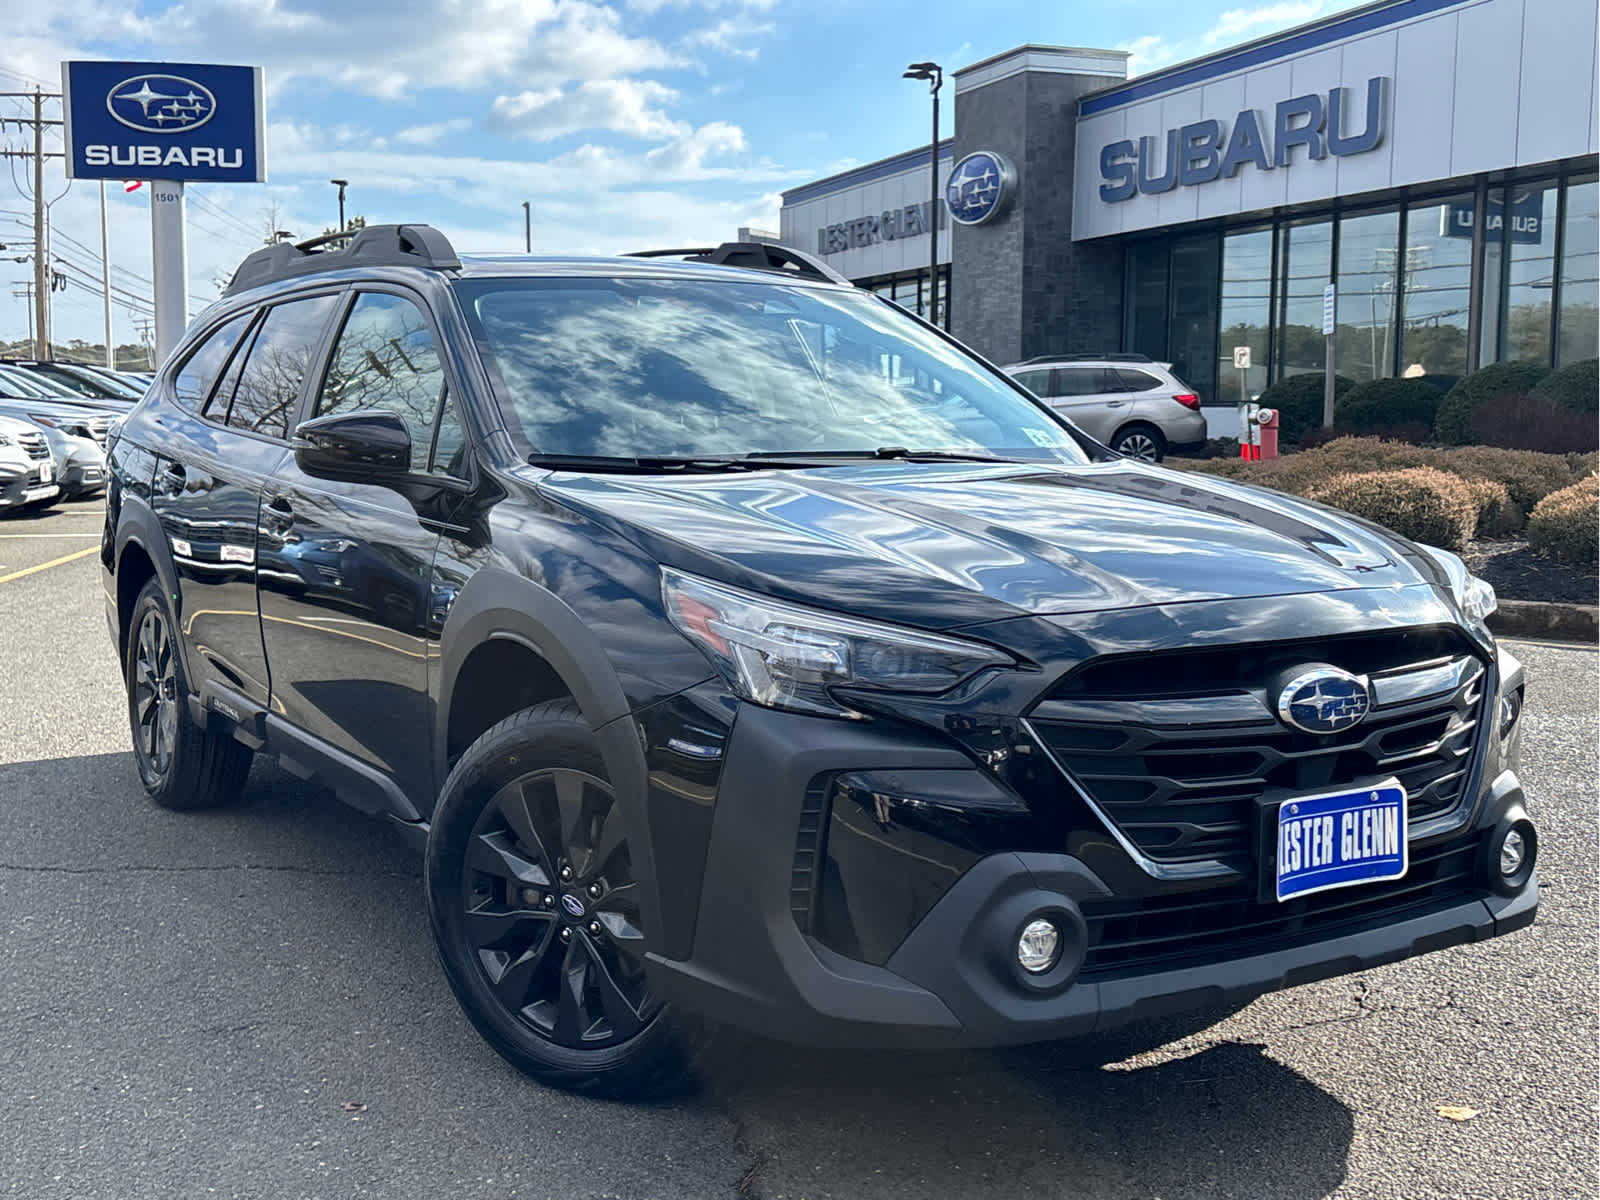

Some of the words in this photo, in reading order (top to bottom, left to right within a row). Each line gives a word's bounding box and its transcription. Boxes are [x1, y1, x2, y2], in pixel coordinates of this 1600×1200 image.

[85, 144, 243, 168] SUBARU
[1099, 76, 1389, 203] SUBARU
[156, 193, 179, 202] 1501
[817, 215, 881, 255] LESTER
[1279, 815, 1334, 877] LESTER
[1340, 806, 1399, 861] GLENN
